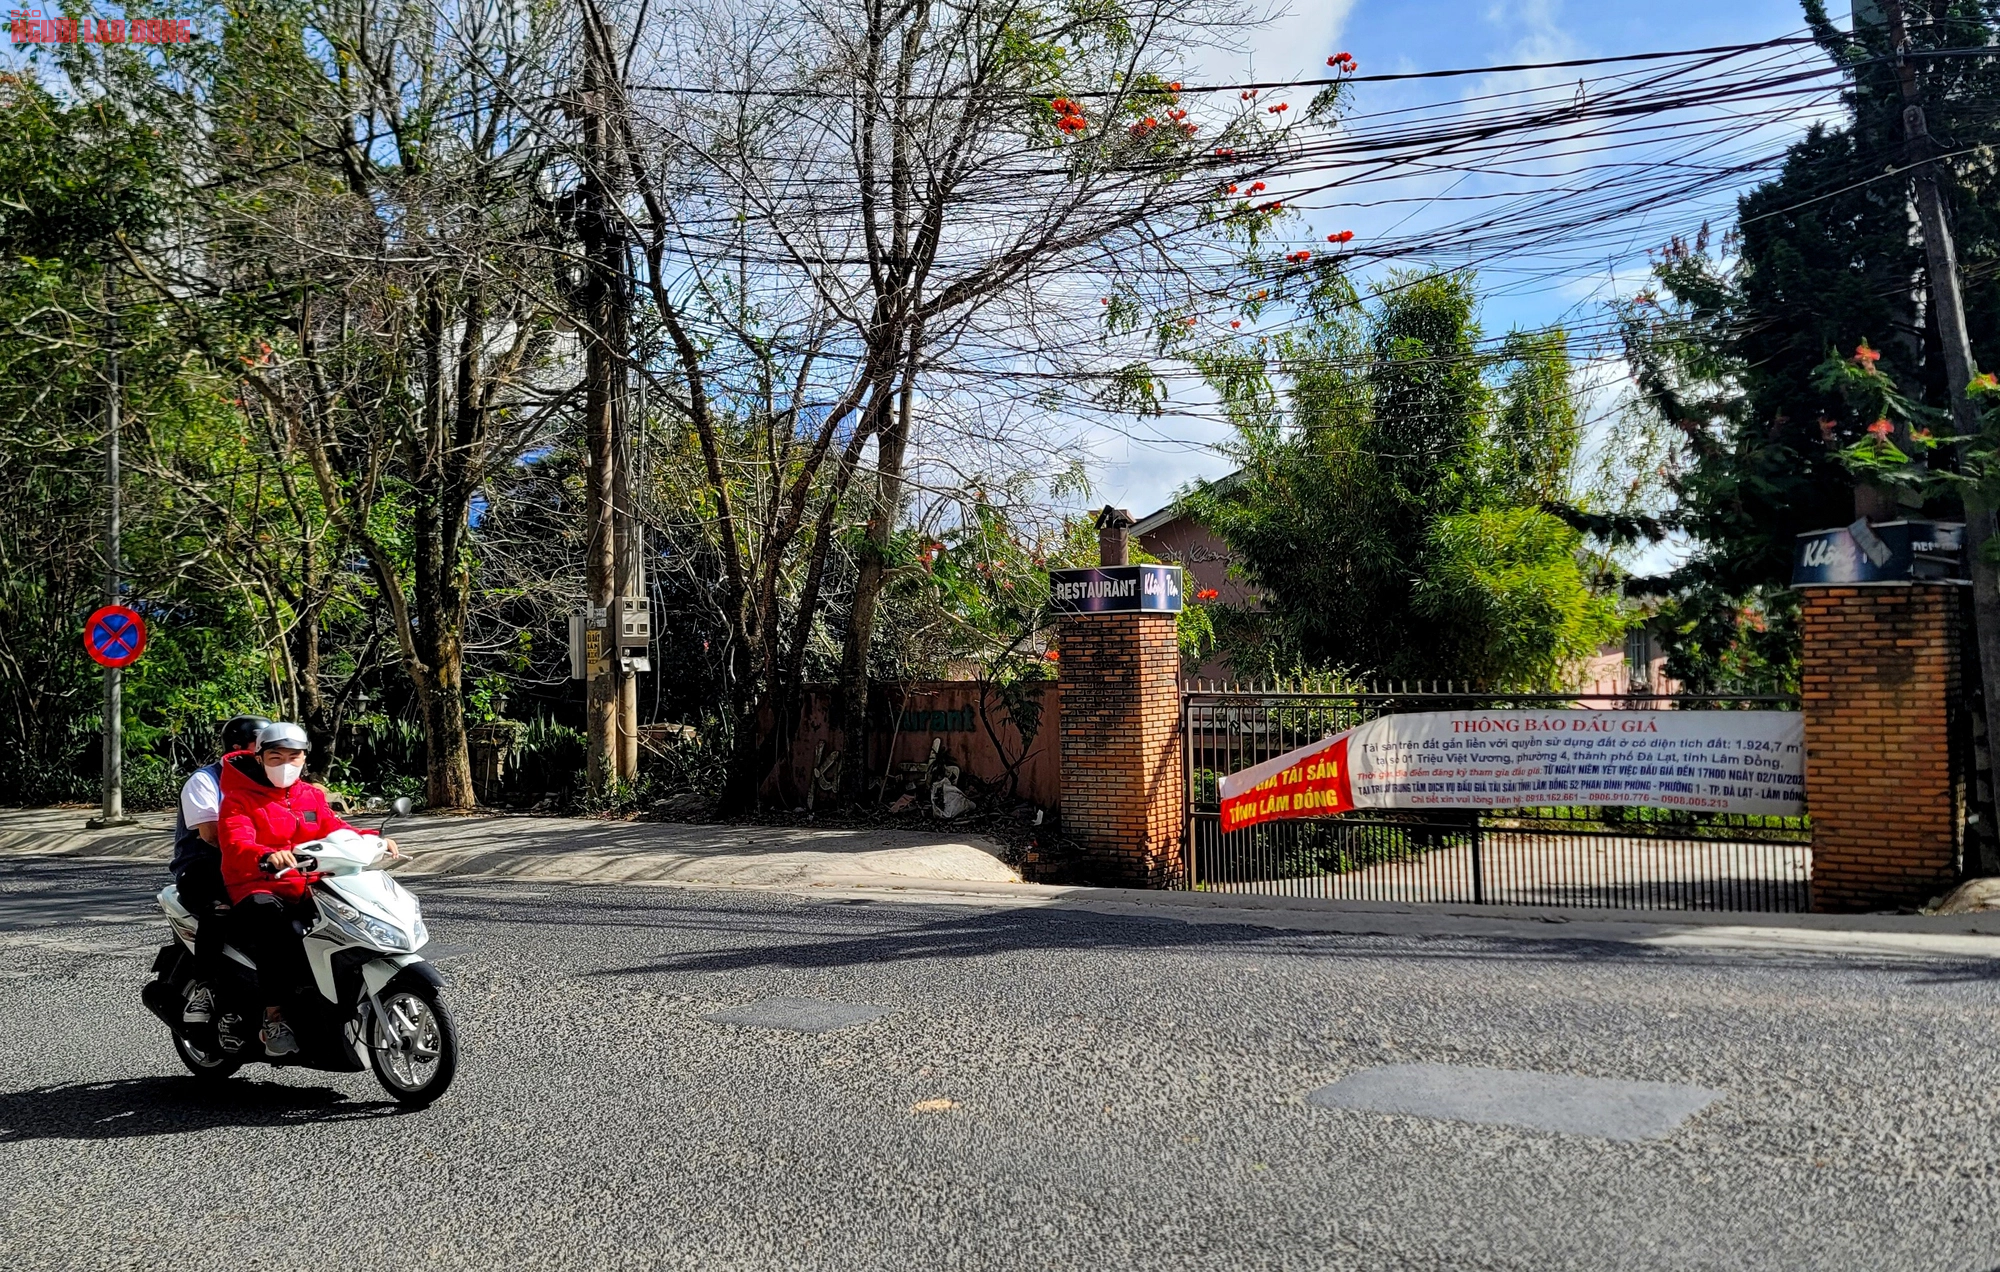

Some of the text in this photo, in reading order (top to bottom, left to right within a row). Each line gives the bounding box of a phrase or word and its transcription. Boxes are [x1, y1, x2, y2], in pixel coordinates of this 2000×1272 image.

[1056, 579, 1136, 600] RESTAURANT
[1451, 713, 1658, 733] THÔNG BÁO ĐẤU GIÁ
[1399, 740, 1420, 750] trên
[1422, 738, 1440, 750] đất
[1466, 737, 1486, 749] liền
[1488, 738, 1508, 748] với
[1512, 735, 1542, 750] quyền
[1544, 737, 1562, 746] sử
[1564, 738, 1594, 749] dụng
[1597, 736, 1616, 748] đất
[1620, 738, 1629, 748] ở
[1632, 738, 1646, 747] có
[1650, 738, 1676, 750] diện
[1680, 738, 1702, 748] tích
[1706, 738, 1731, 749] đất:
[1736, 740, 1782, 753] 1.924,7
[1402, 754, 1412, 764] 01
[1417, 754, 1444, 765] Triệu
[1446, 753, 1468, 764] Việt
[1470, 754, 1514, 764] Vương,
[1517, 752, 1557, 764] phường
[1560, 752, 1570, 762] 4,
[1573, 752, 1606, 761] thành
[1610, 752, 1634, 764] phố
[1637, 752, 1653, 762] Đà
[1657, 752, 1680, 764] Lạt,
[1683, 753, 1707, 762] tỉnh
[1712, 754, 1740, 765] Lâm
[1744, 754, 1784, 770] Đồng.
[1282, 766, 1303, 786] TÀI
[1306, 758, 1338, 780] SẢN
[1555, 763, 1576, 774] NGÀY
[1578, 764, 1600, 774] NIÊM
[1619, 764, 1638, 777] VIỆC
[1640, 763, 1658, 776] ĐẤU
[1660, 764, 1674, 776] GIÁ
[1676, 764, 1696, 777] ĐẾN
[1698, 768, 1726, 780] 17H00
[1728, 768, 1754, 783] NGÀY
[1532, 779, 1547, 790] LÂM
[1548, 778, 1568, 790] ĐỒNG
[1569, 780, 1580, 790] 52
[1580, 780, 1602, 790] PHAN
[1603, 779, 1623, 790] ĐÌNH
[1624, 780, 1652, 790] PHÙNG
[1659, 781, 1694, 794] PHƯỜNG
[1709, 785, 1721, 796] TP.
[1724, 783, 1736, 796] ĐÀ
[1738, 787, 1753, 800] LẠT
[1762, 786, 1780, 800] LÂM
[1783, 788, 1805, 802] ĐỒN
[1229, 786, 1338, 824] TỈNH LÂM ĐỒNG
